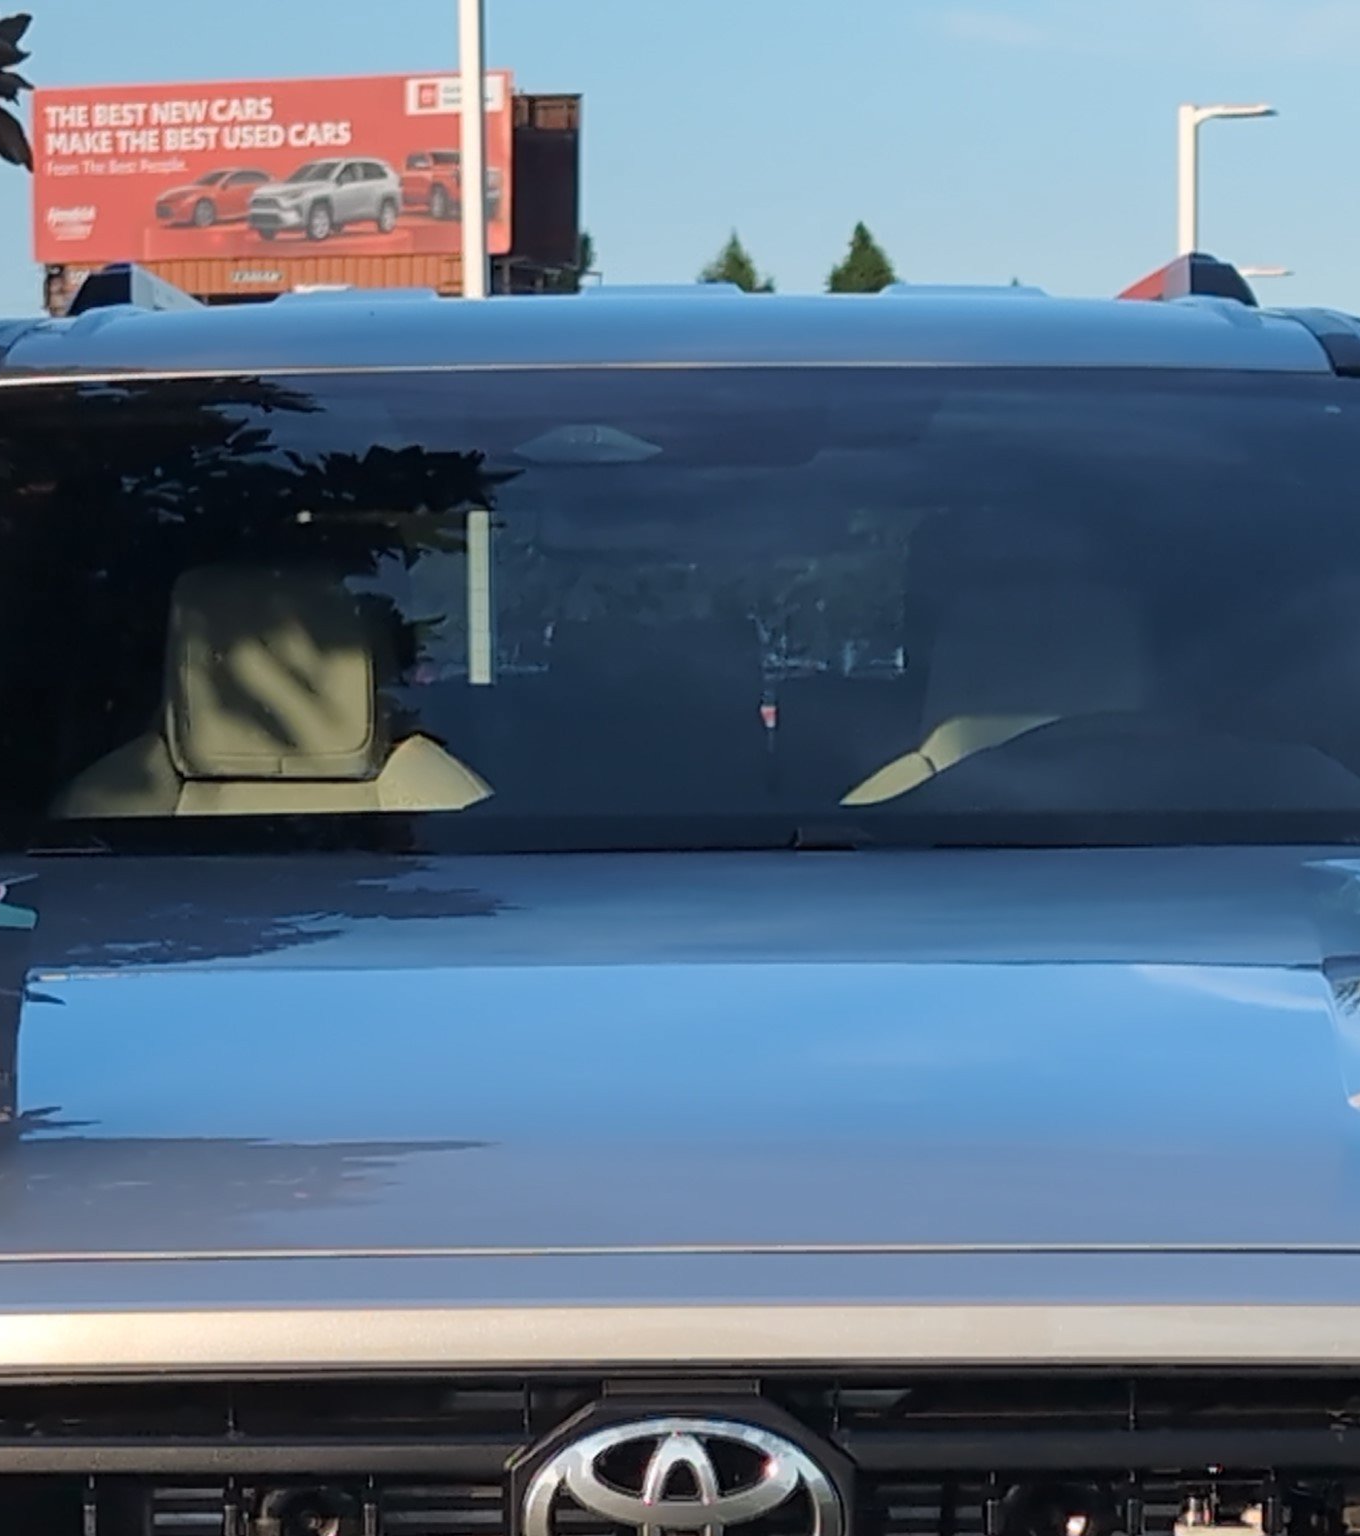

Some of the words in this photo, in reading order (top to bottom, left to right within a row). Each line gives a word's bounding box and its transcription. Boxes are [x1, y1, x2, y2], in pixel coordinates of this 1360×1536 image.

[45, 104, 89, 128] THE
[92, 102, 148, 127] BEST
[151, 99, 208, 125] NEW
[209, 96, 273, 122] CARS
[46, 130, 113, 155] MAKE
[116, 128, 160, 153] THE
[163, 125, 219, 151] BEST
[222, 123, 285, 149] USED
[288, 121, 352, 147] CARS
